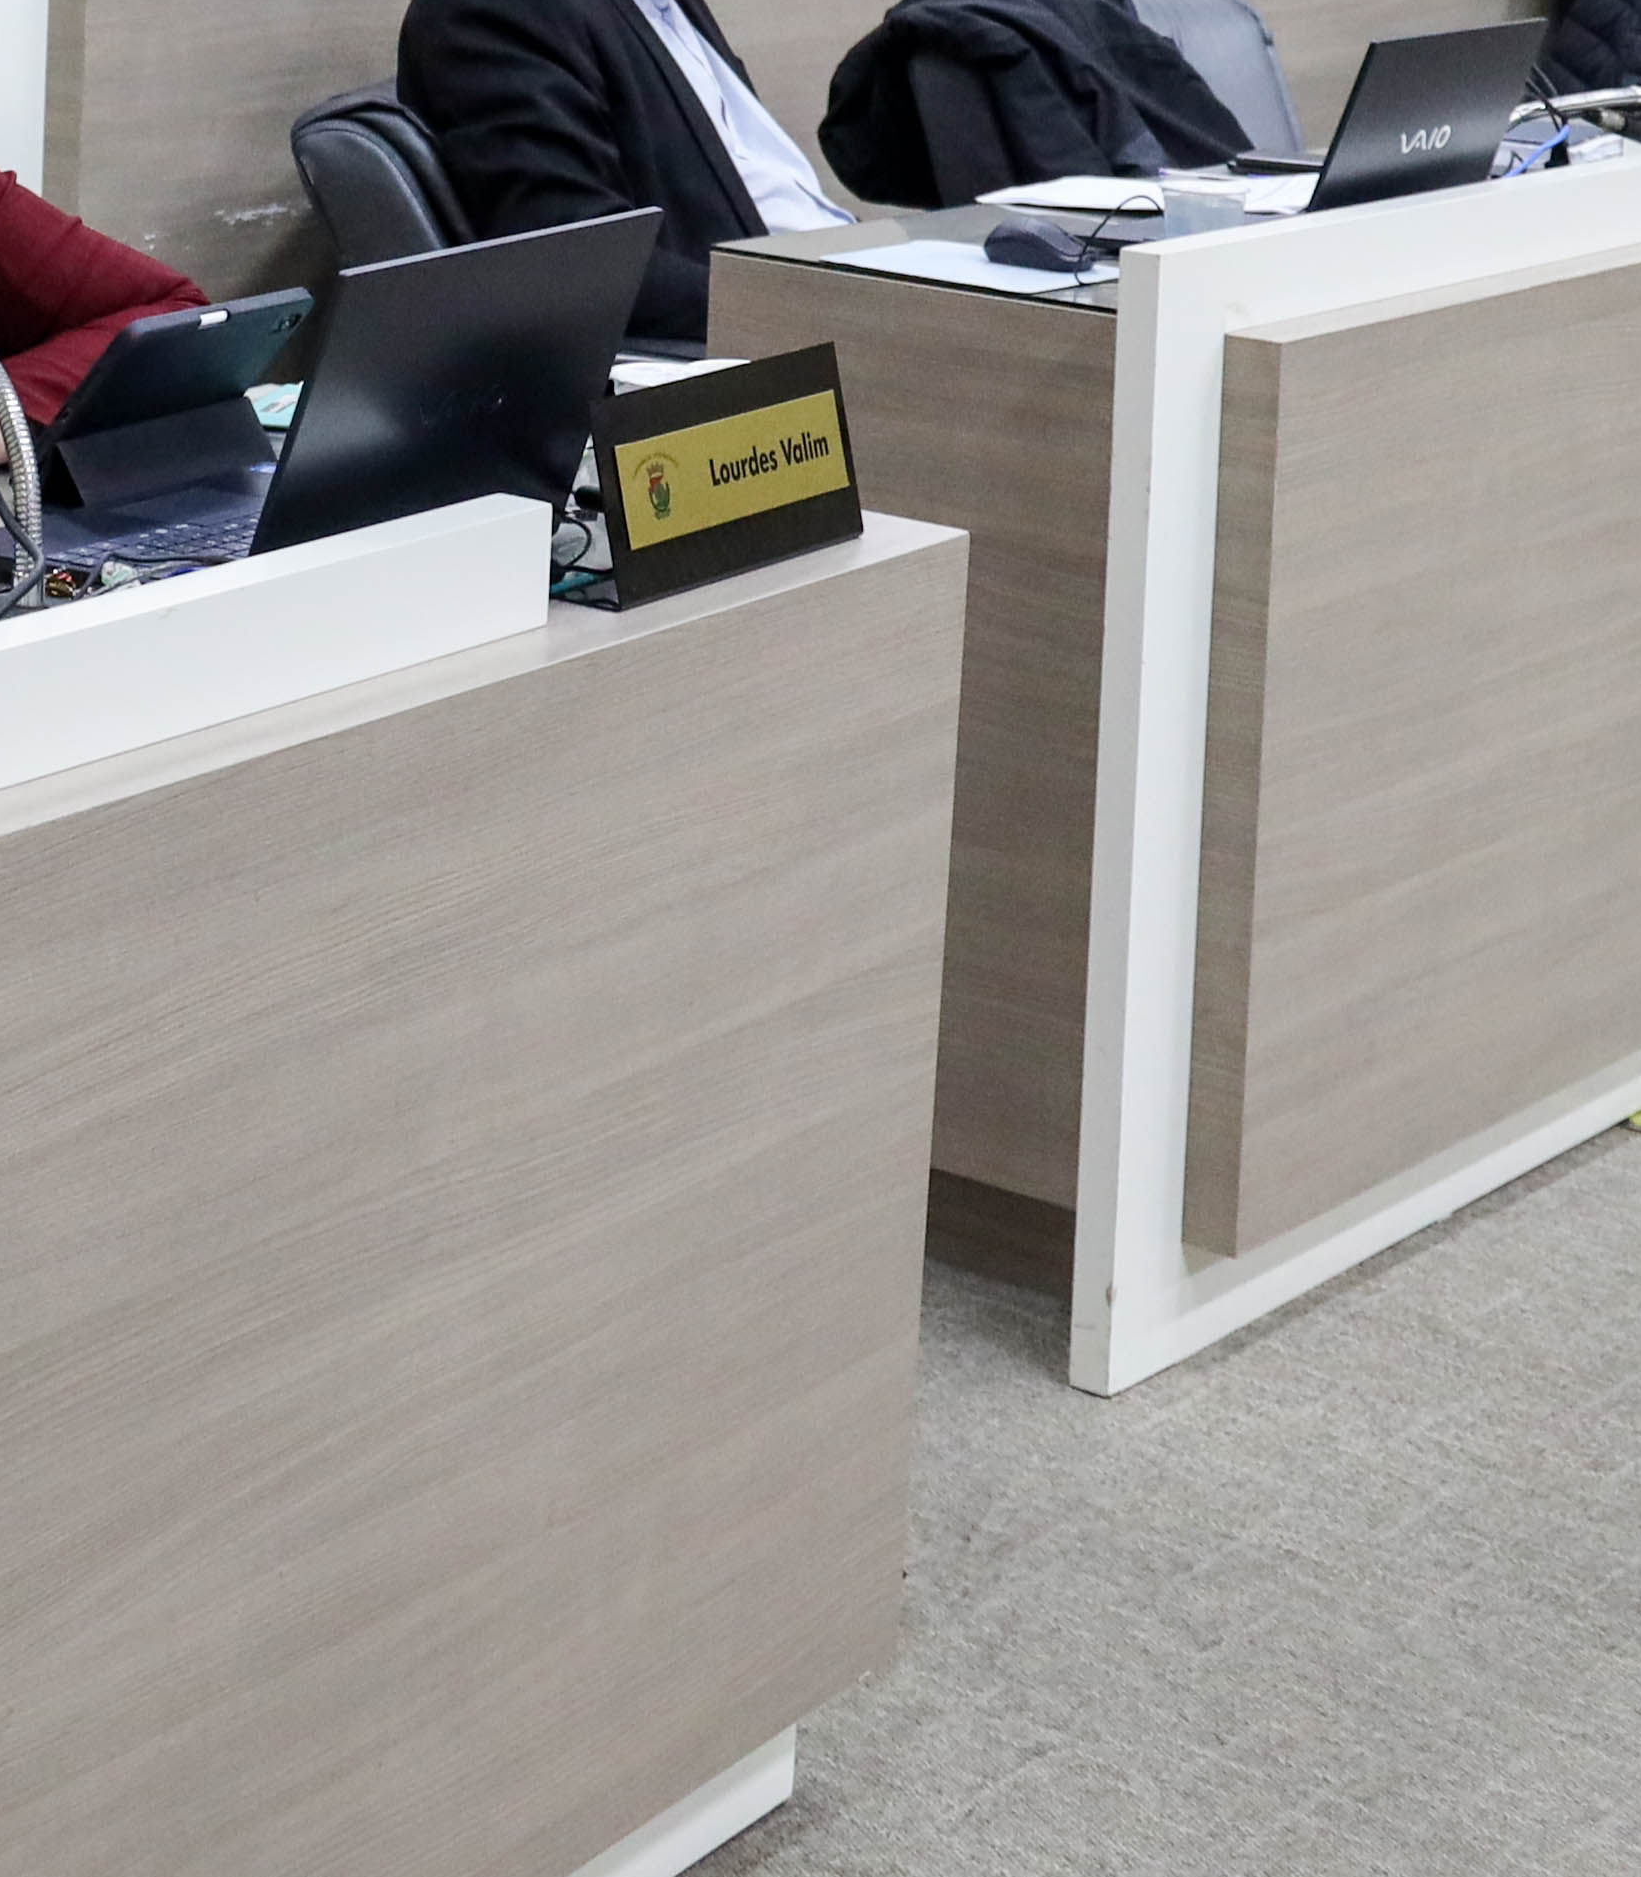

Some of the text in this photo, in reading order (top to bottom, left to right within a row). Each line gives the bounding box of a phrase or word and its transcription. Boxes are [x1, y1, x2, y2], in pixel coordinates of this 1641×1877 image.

[1400, 124, 1452, 155] VAIO
[709, 445, 778, 487] Lourdes
[780, 431, 830, 466] Valim
